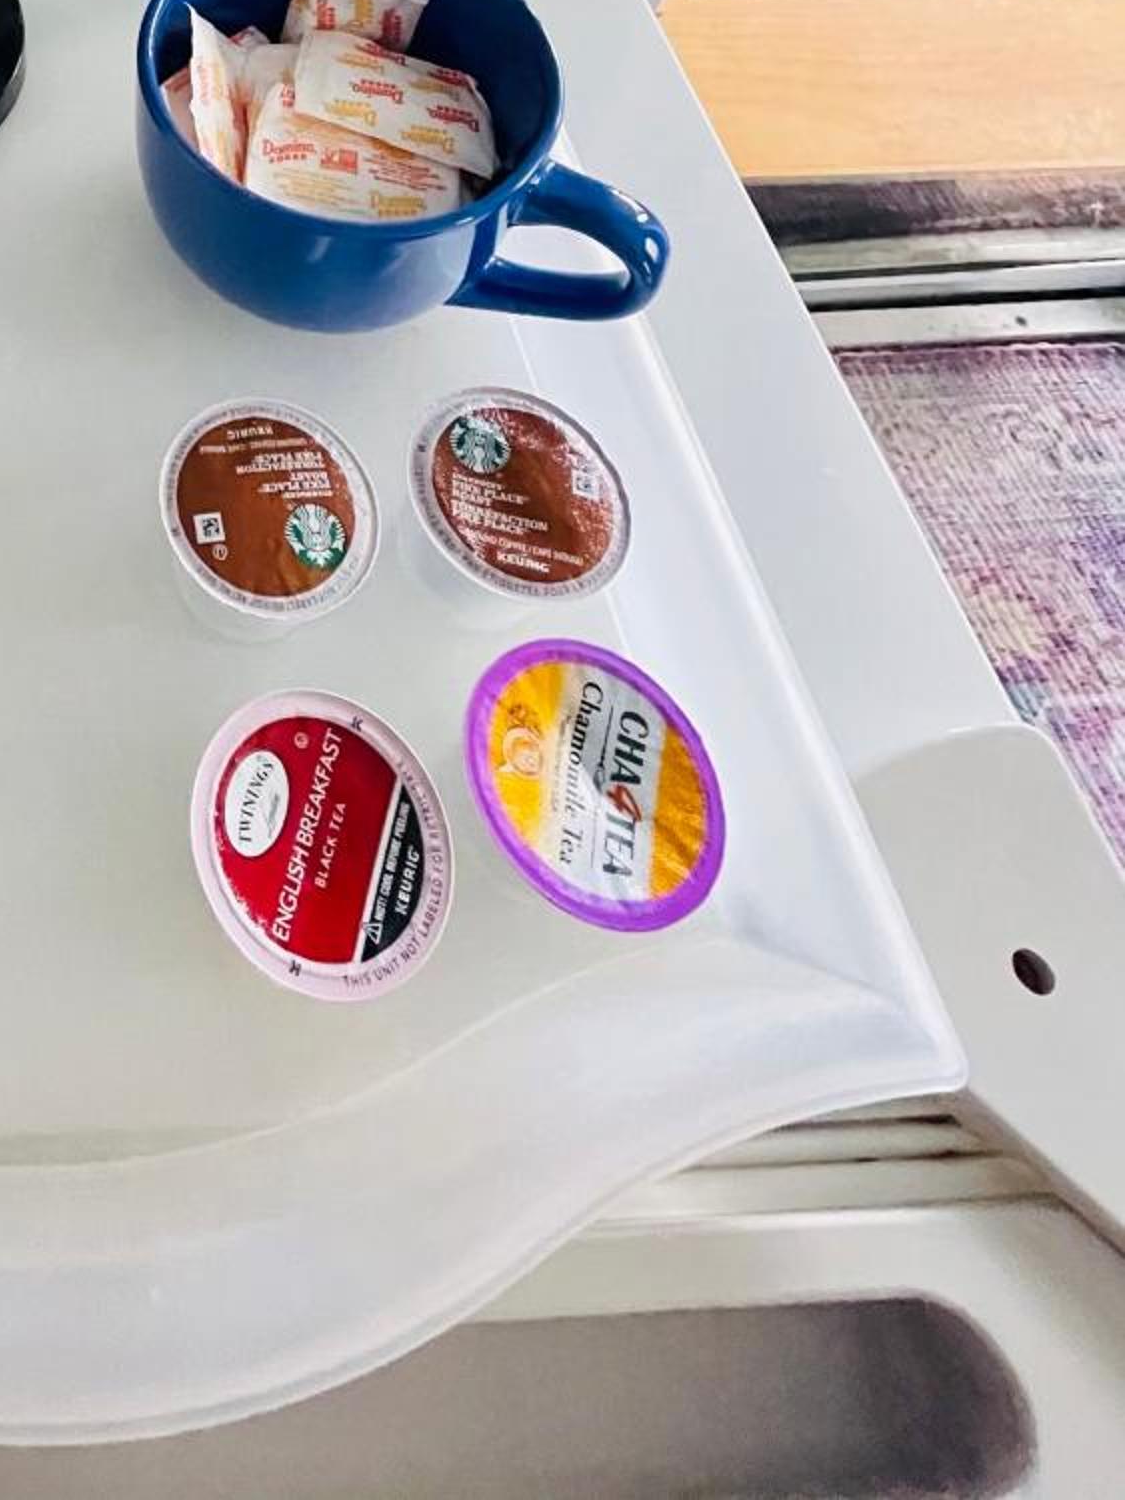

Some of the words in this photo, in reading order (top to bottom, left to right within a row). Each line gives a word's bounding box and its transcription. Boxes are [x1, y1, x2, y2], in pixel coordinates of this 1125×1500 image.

[564, 680, 604, 815] Chamomile
[238, 761, 275, 843] TWININGS
[272, 849, 310, 942] ENGLISH
[295, 728, 343, 847] BREAKFAST
[315, 835, 340, 889] BLACK
[330, 802, 347, 833] TEA
[394, 845, 421, 915] KEURIG
[558, 826, 584, 866] Tea
[342, 972, 373, 988] THIS
[374, 957, 400, 982] UNIT
[402, 937, 421, 960] NOT
[422, 880, 444, 938] LABELED
